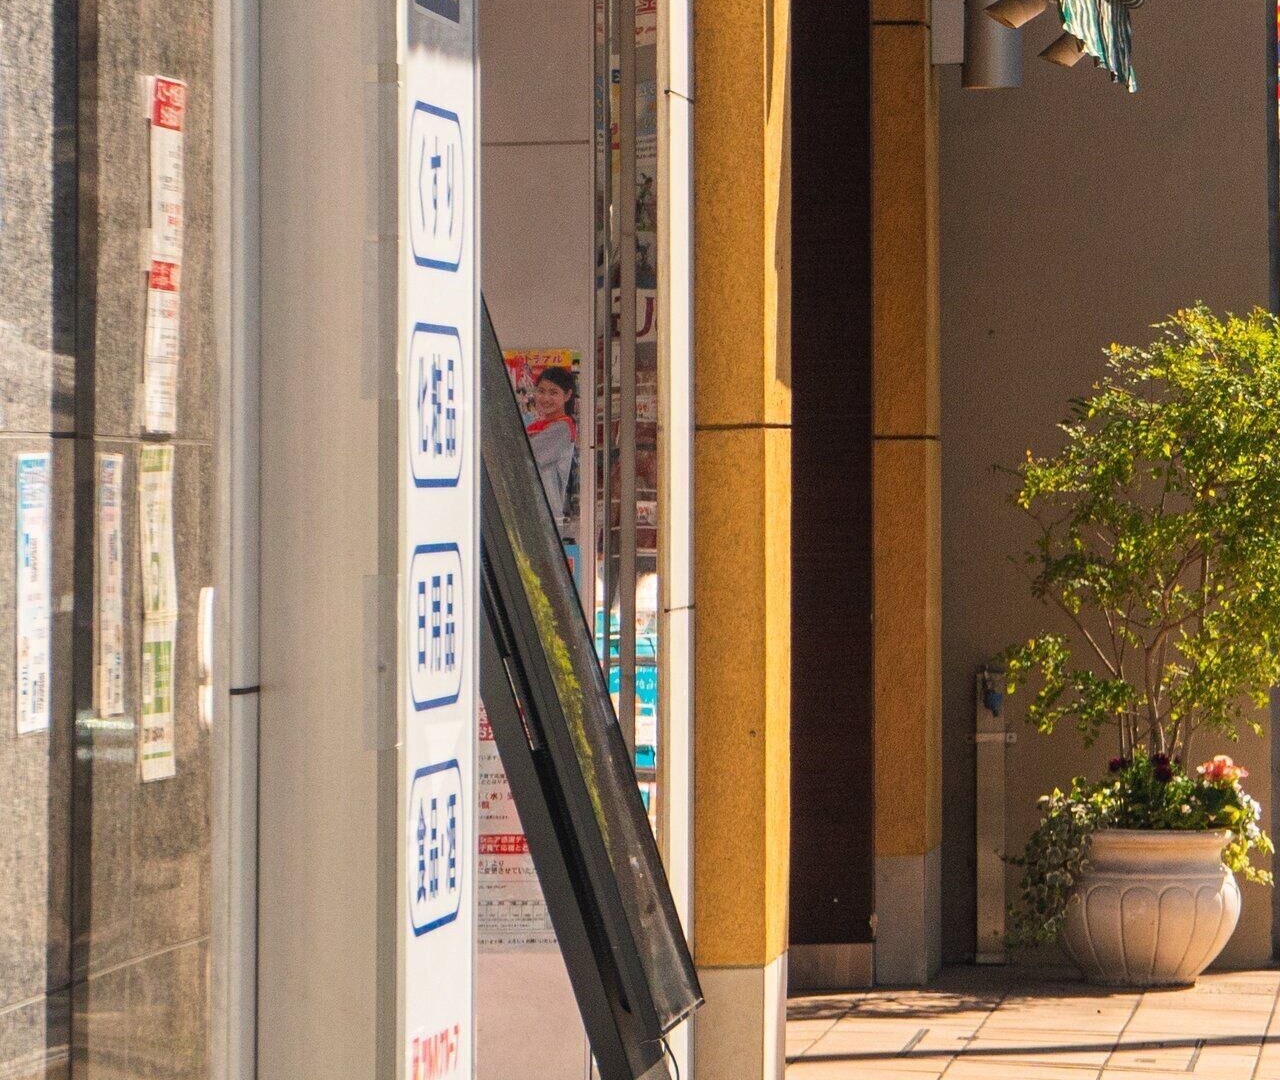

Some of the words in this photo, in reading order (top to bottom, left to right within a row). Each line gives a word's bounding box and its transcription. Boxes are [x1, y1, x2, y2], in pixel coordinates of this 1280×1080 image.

[419, 135, 454, 240] くすり
[418, 353, 456, 458] 化粧品
[418, 573, 456, 672] 日用品
[417, 793, 456, 904] 食品・酒
